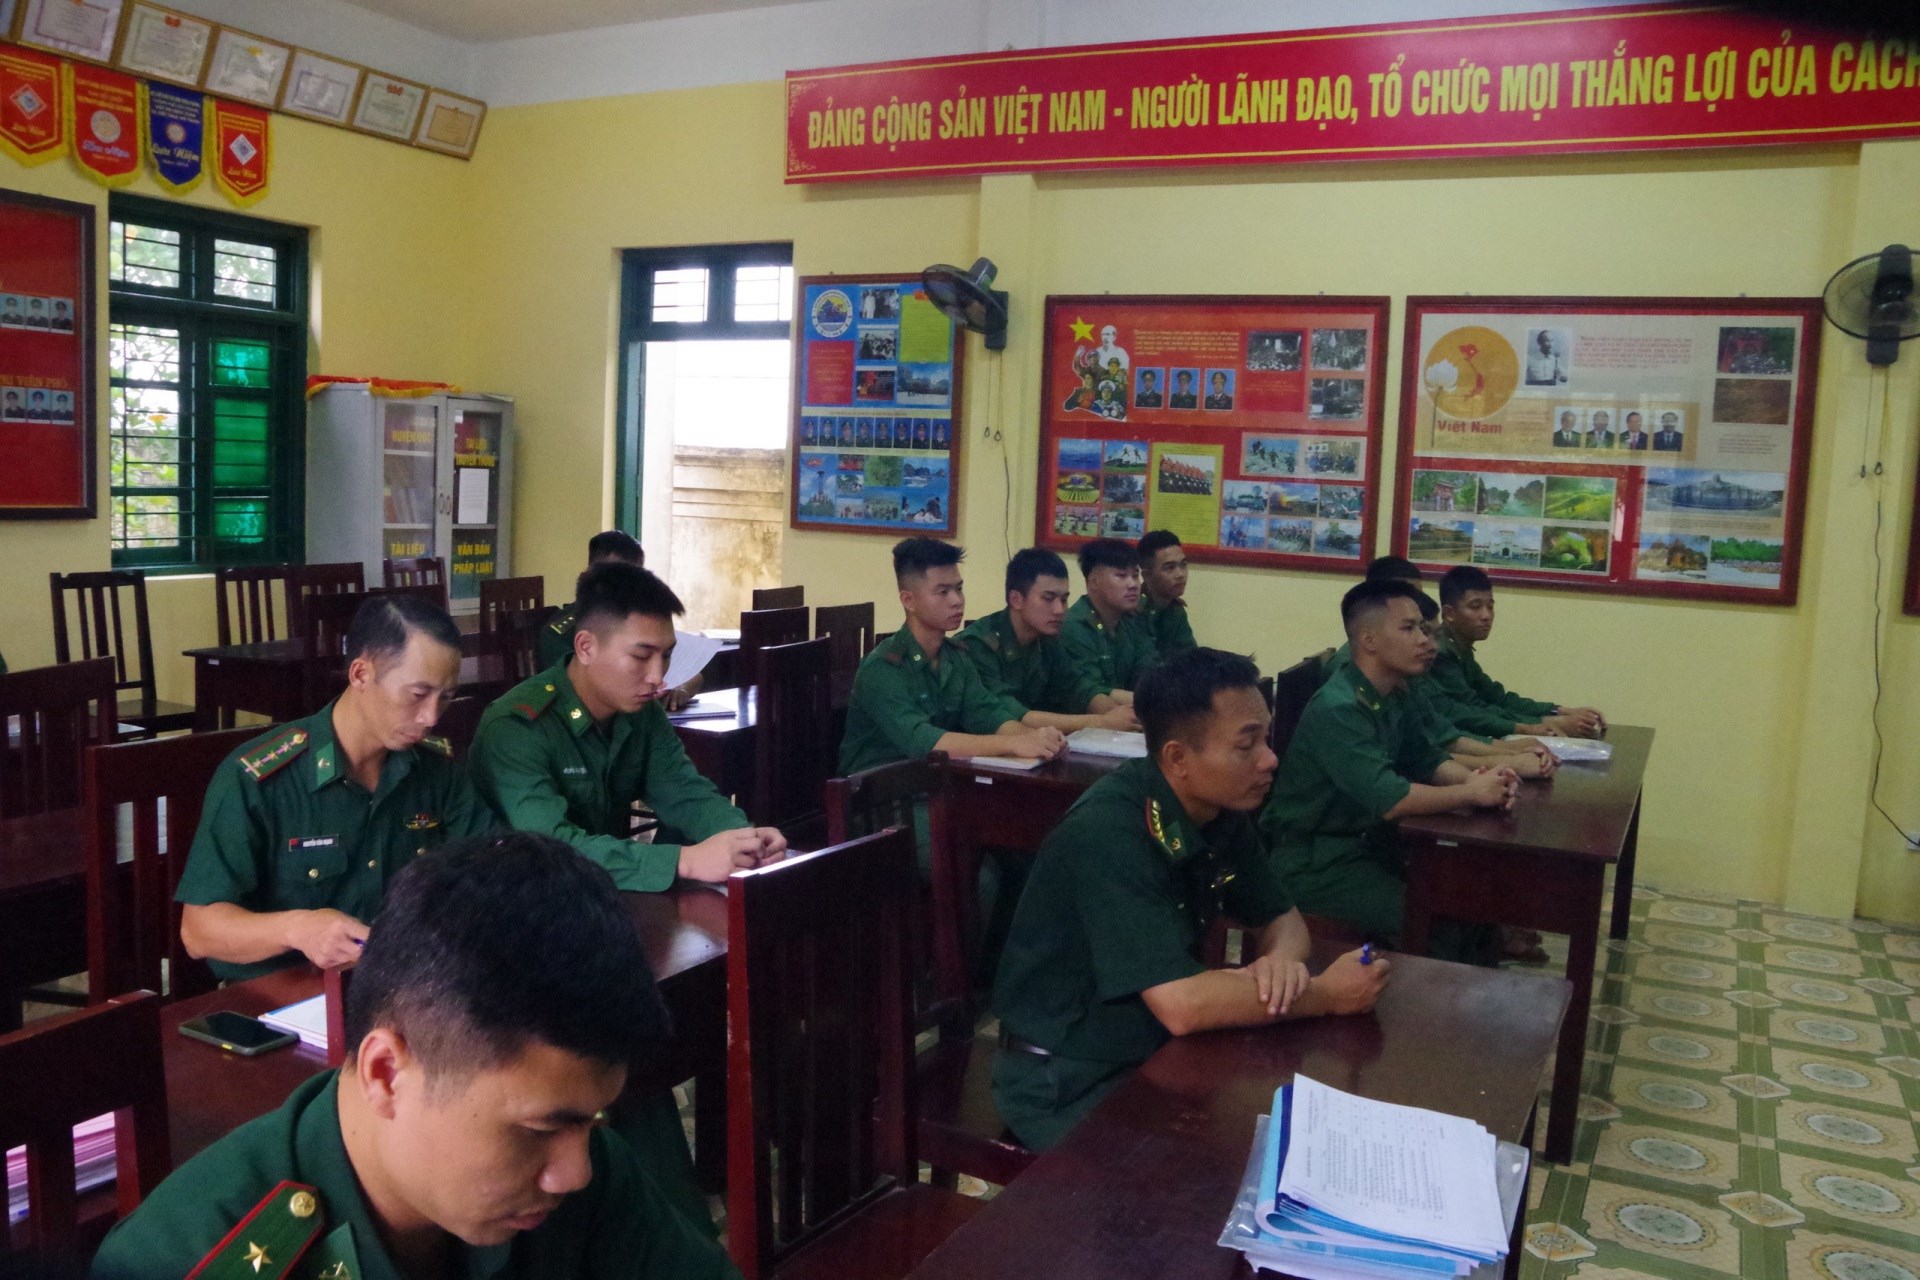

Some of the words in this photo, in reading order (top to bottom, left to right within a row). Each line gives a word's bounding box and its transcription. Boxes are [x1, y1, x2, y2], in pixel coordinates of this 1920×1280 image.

[808, 96, 866, 149] ĐẢNG
[871, 95, 932, 152] CỘNG
[938, 85, 987, 139] SẢN
[993, 86, 1043, 145] VIỆT
[1049, 89, 1106, 132] NAM
[1114, 107, 1123, 117] -
[1131, 74, 1210, 129] NGƯỜI
[1218, 73, 1289, 125] LÃNH
[1296, 75, 1359, 130] ĐẠO,
[1368, 53, 1406, 118] TỔ
[1411, 58, 1490, 116] CHỨC
[1500, 62, 1559, 121] MỌI
[1570, 40, 1675, 108] THẮNG
[1684, 45, 1738, 113] LỢI
[1747, 30, 1817, 99] CỦA
[1470, 421, 1503, 434] Nam
